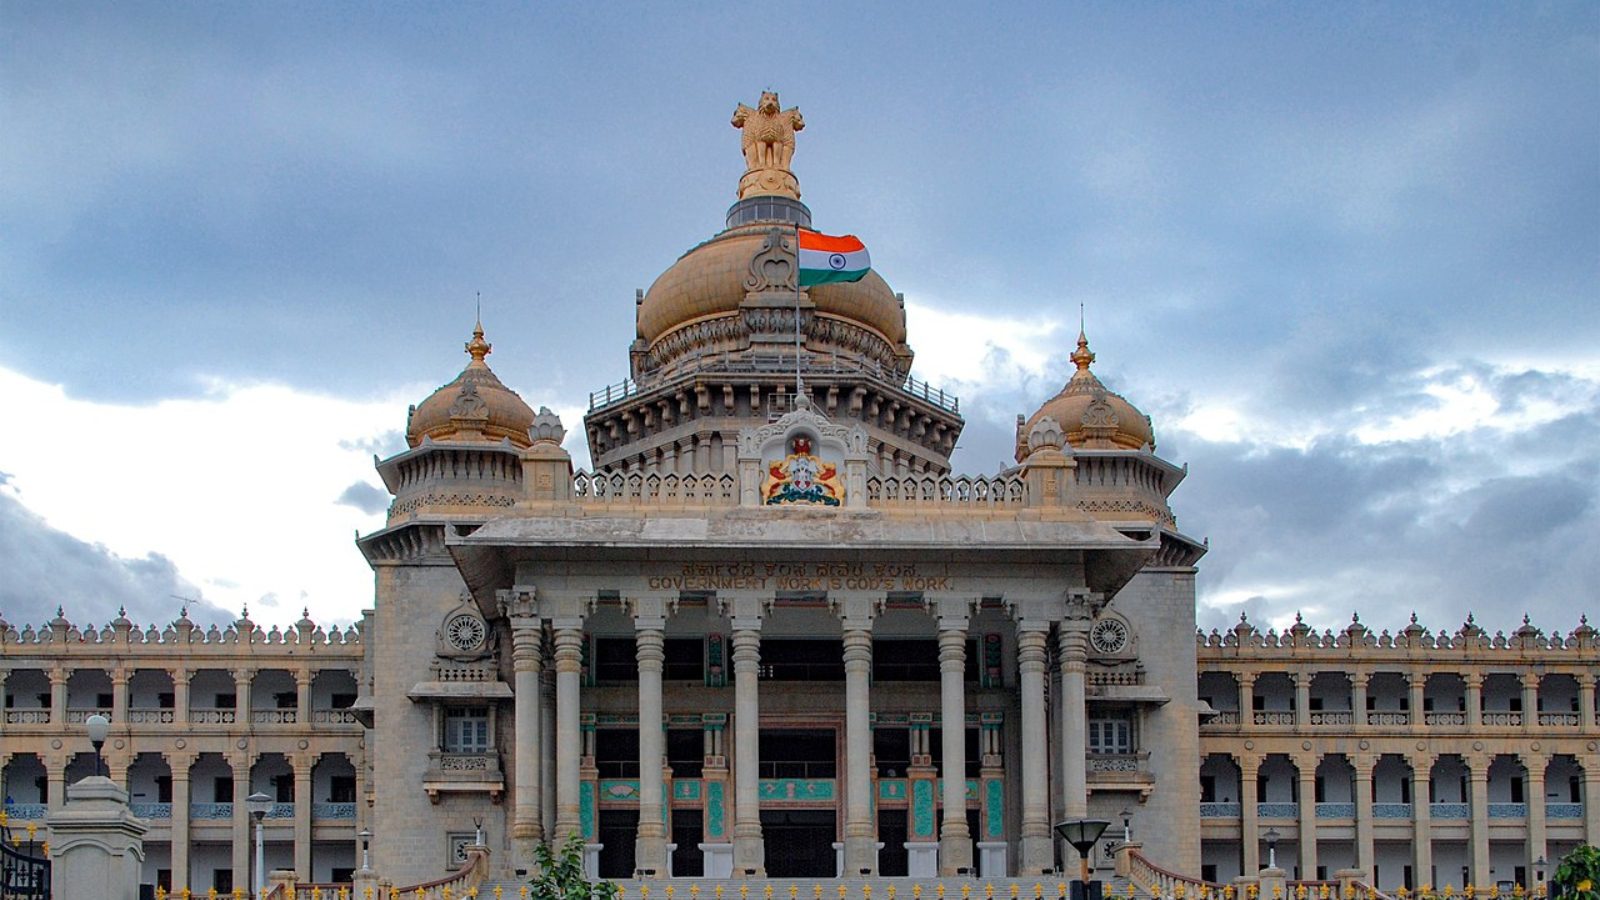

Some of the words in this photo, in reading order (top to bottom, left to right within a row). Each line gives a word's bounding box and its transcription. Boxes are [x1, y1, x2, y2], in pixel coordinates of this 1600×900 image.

[648, 576, 768, 590] GOVERNMENT
[776, 576, 821, 590] WORK
[827, 577, 843, 590] IS
[846, 577, 896, 590] GOD'S
